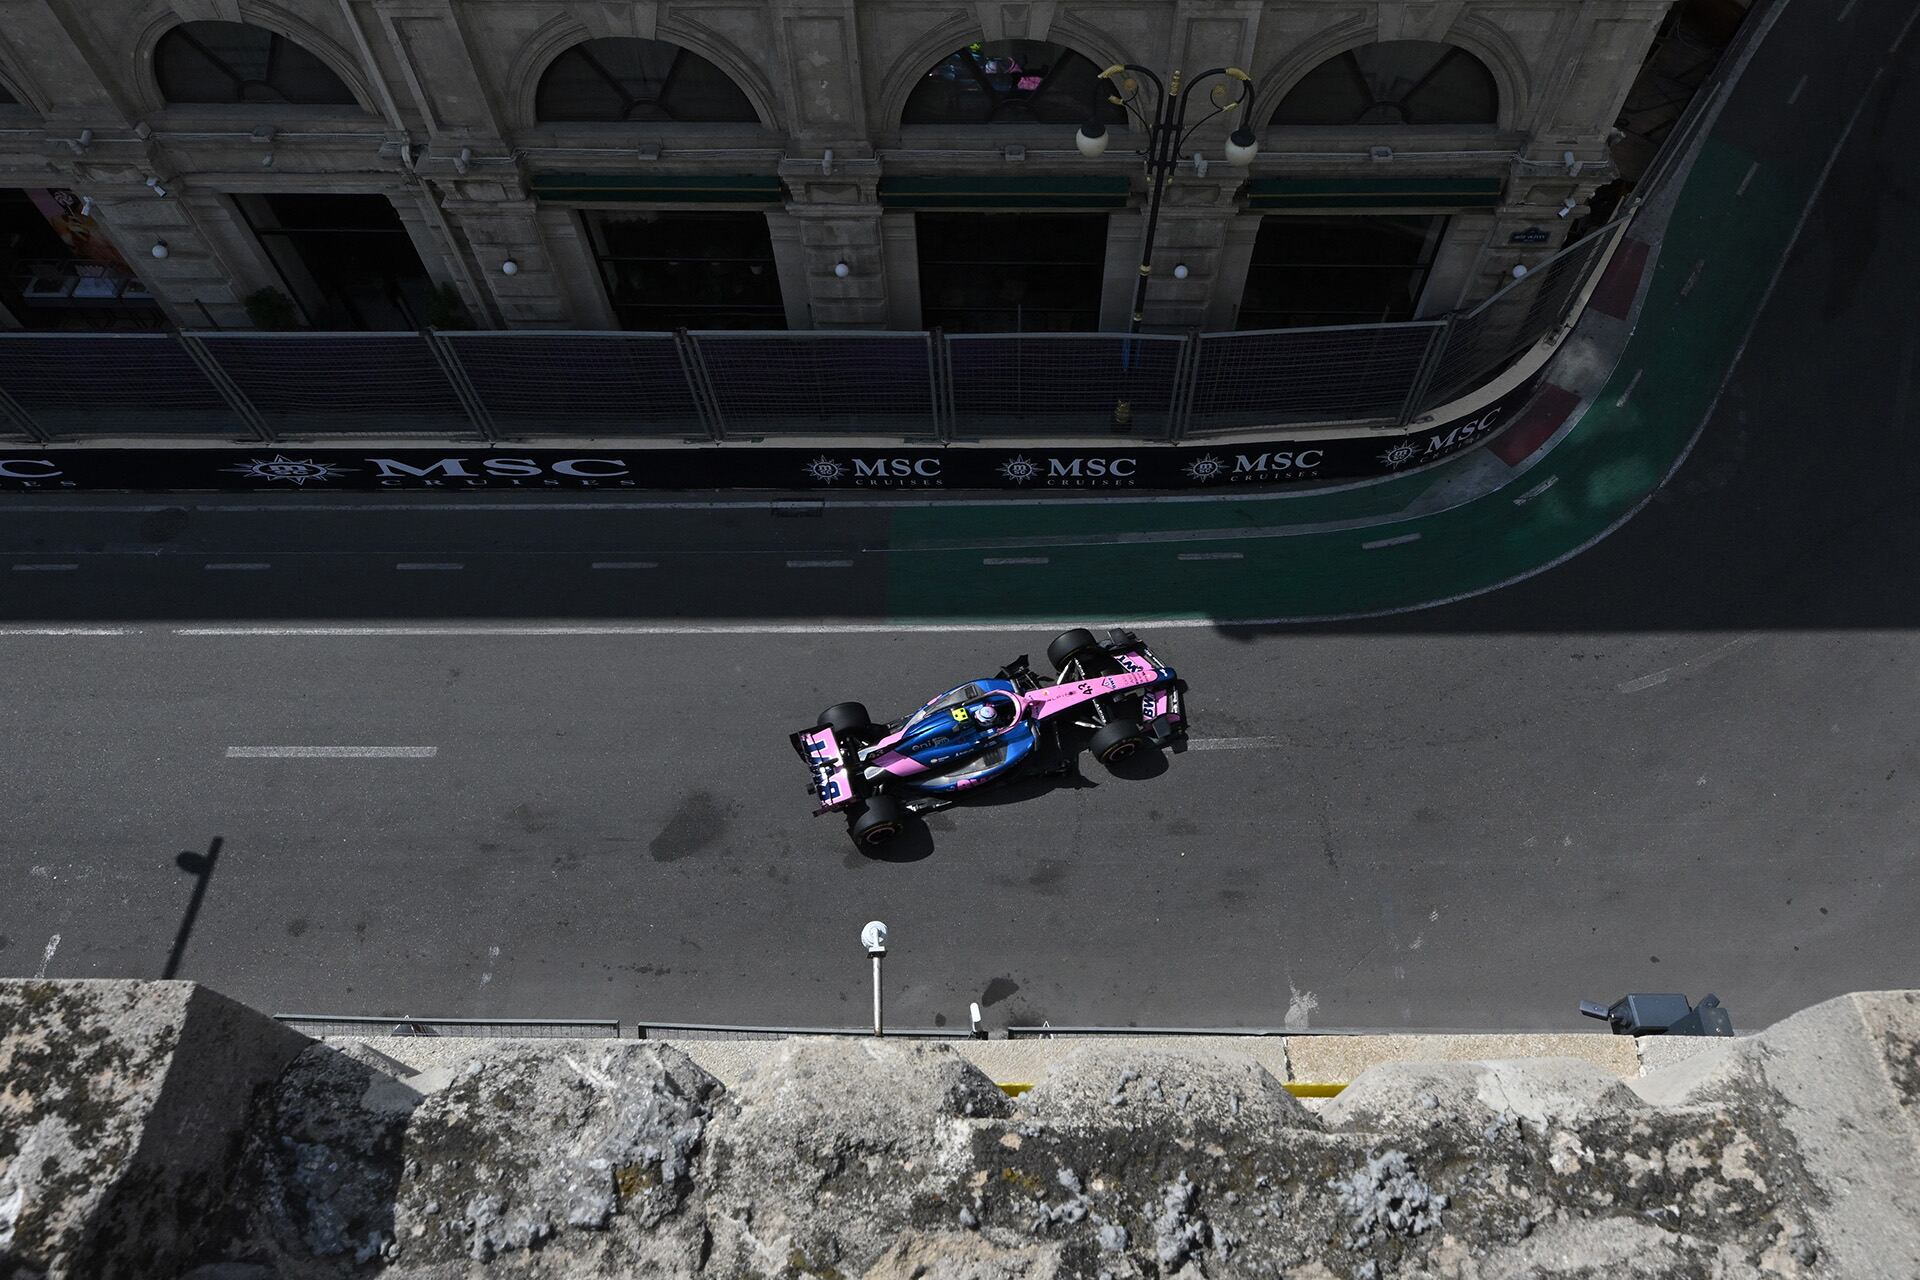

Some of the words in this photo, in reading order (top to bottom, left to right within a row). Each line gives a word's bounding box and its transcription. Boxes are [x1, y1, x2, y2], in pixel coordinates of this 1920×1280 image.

[1423, 406, 1503, 455] MSC
[363, 458, 630, 477] MSC
[851, 458, 942, 477] MSC
[1047, 458, 1137, 477] MSC
[1232, 450, 1324, 473] MSC
[1230, 471, 1319, 482] CRUISES
[1078, 682, 1093, 696] 43
[1143, 690, 1155, 719] BW
